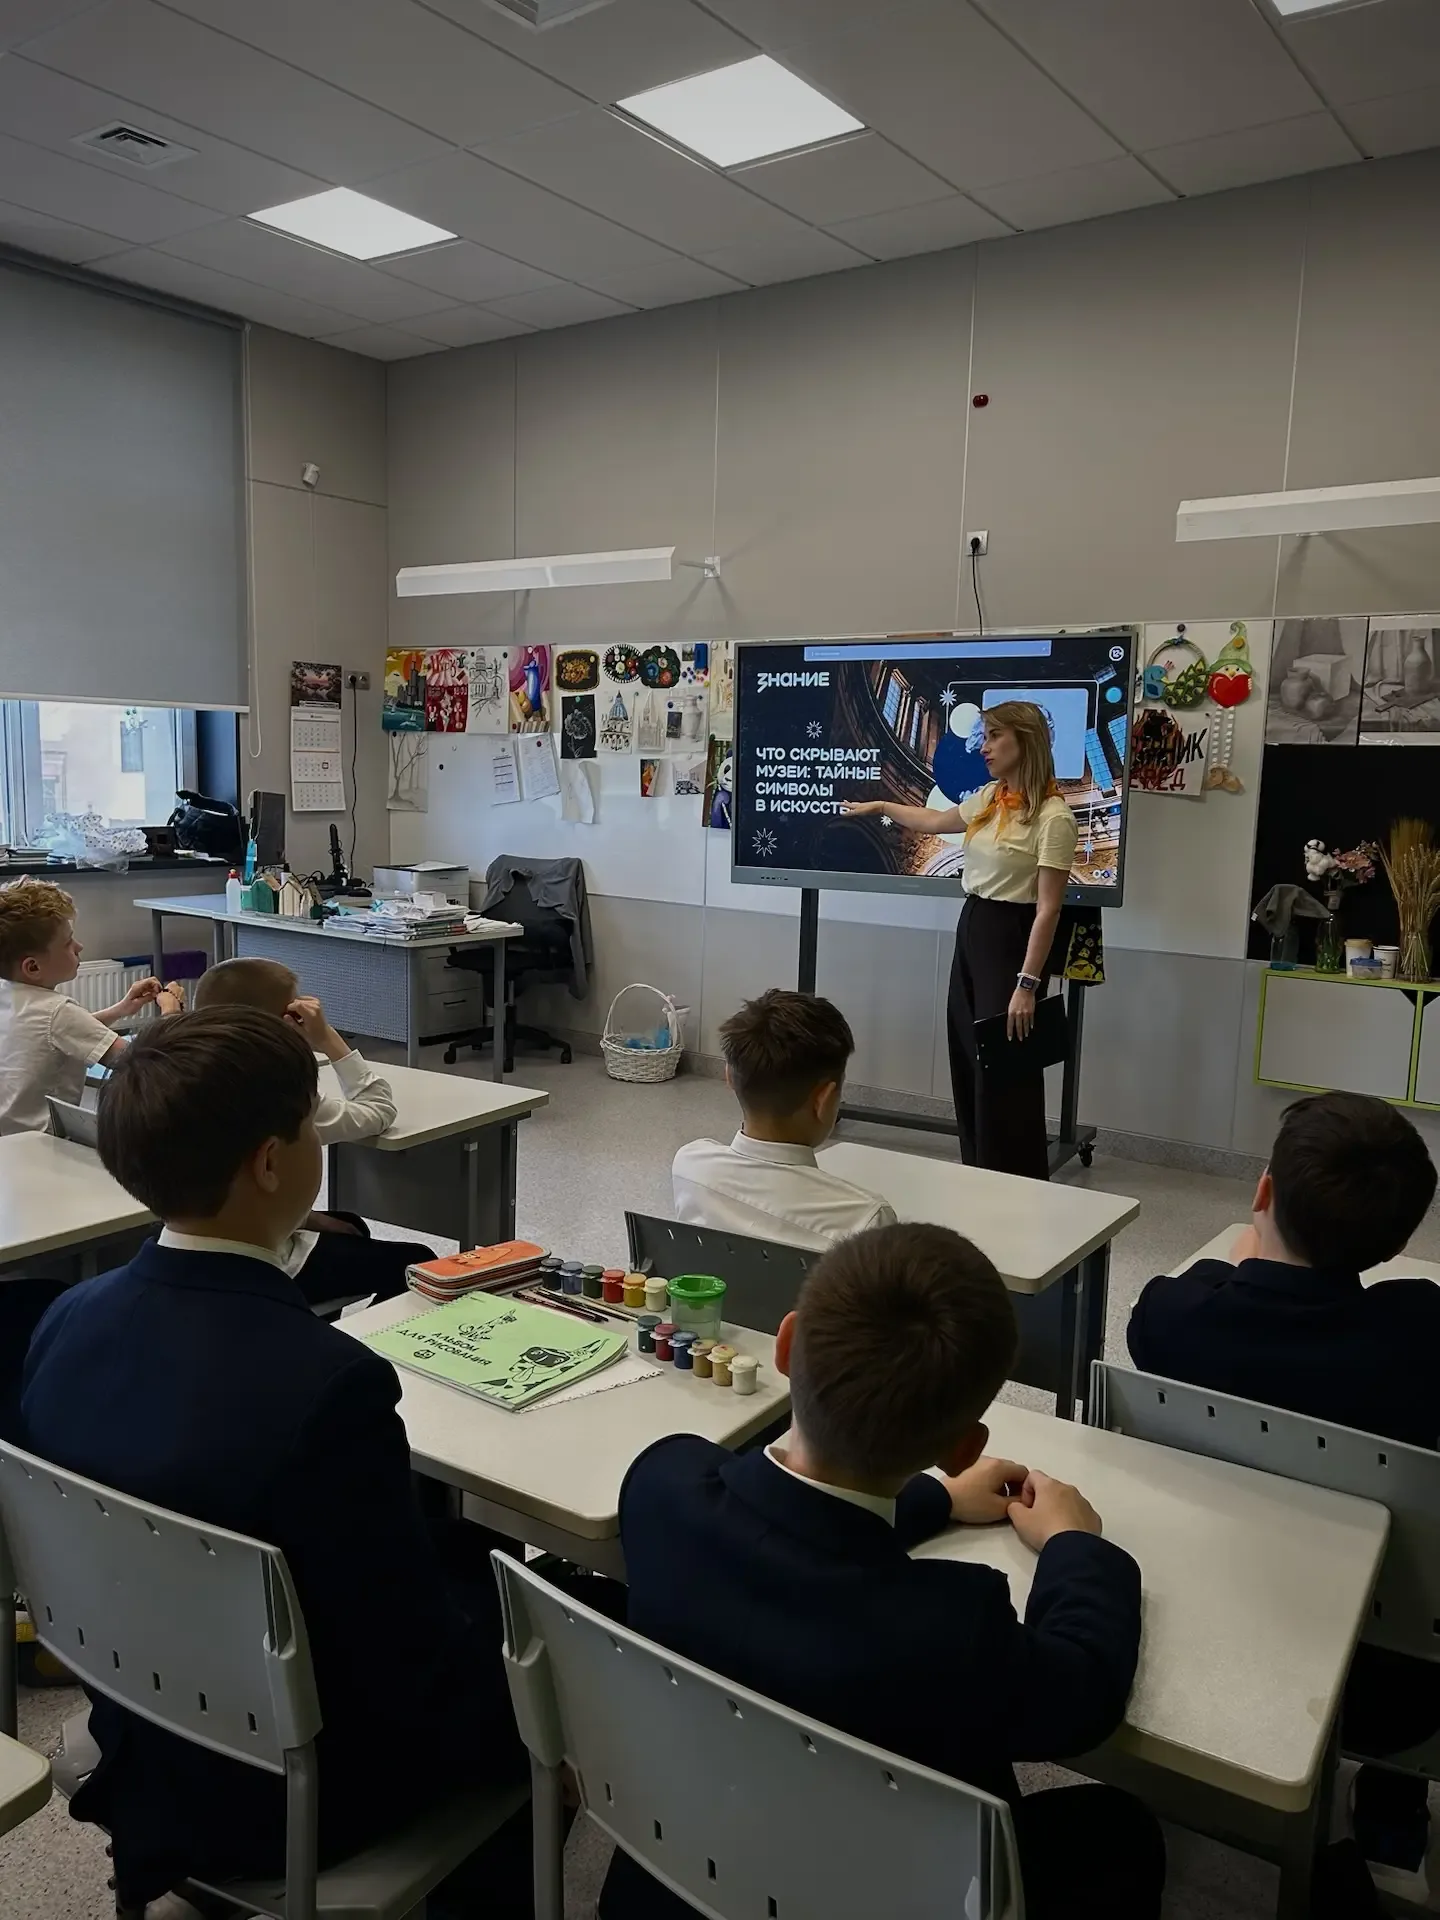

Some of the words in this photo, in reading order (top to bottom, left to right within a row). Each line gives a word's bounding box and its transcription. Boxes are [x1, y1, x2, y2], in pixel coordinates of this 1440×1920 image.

[757, 671, 830, 693] ЗНАНИЕ
[756, 747, 786, 760] ЧТО
[790, 747, 880, 762] СКРЫВАЮТ
[756, 764, 811, 779] МУЗЕИ:
[815, 762, 882, 780] ТАЙНЫЕ
[755, 782, 834, 797] СИМВОЛЫ
[755, 799, 766, 812] В
[396, 1329, 426, 1341] ДЛЯ
[424, 1338, 493, 1366] РИСОВАНИЯ
[432, 1332, 480, 1352] АЛЬБОМ
